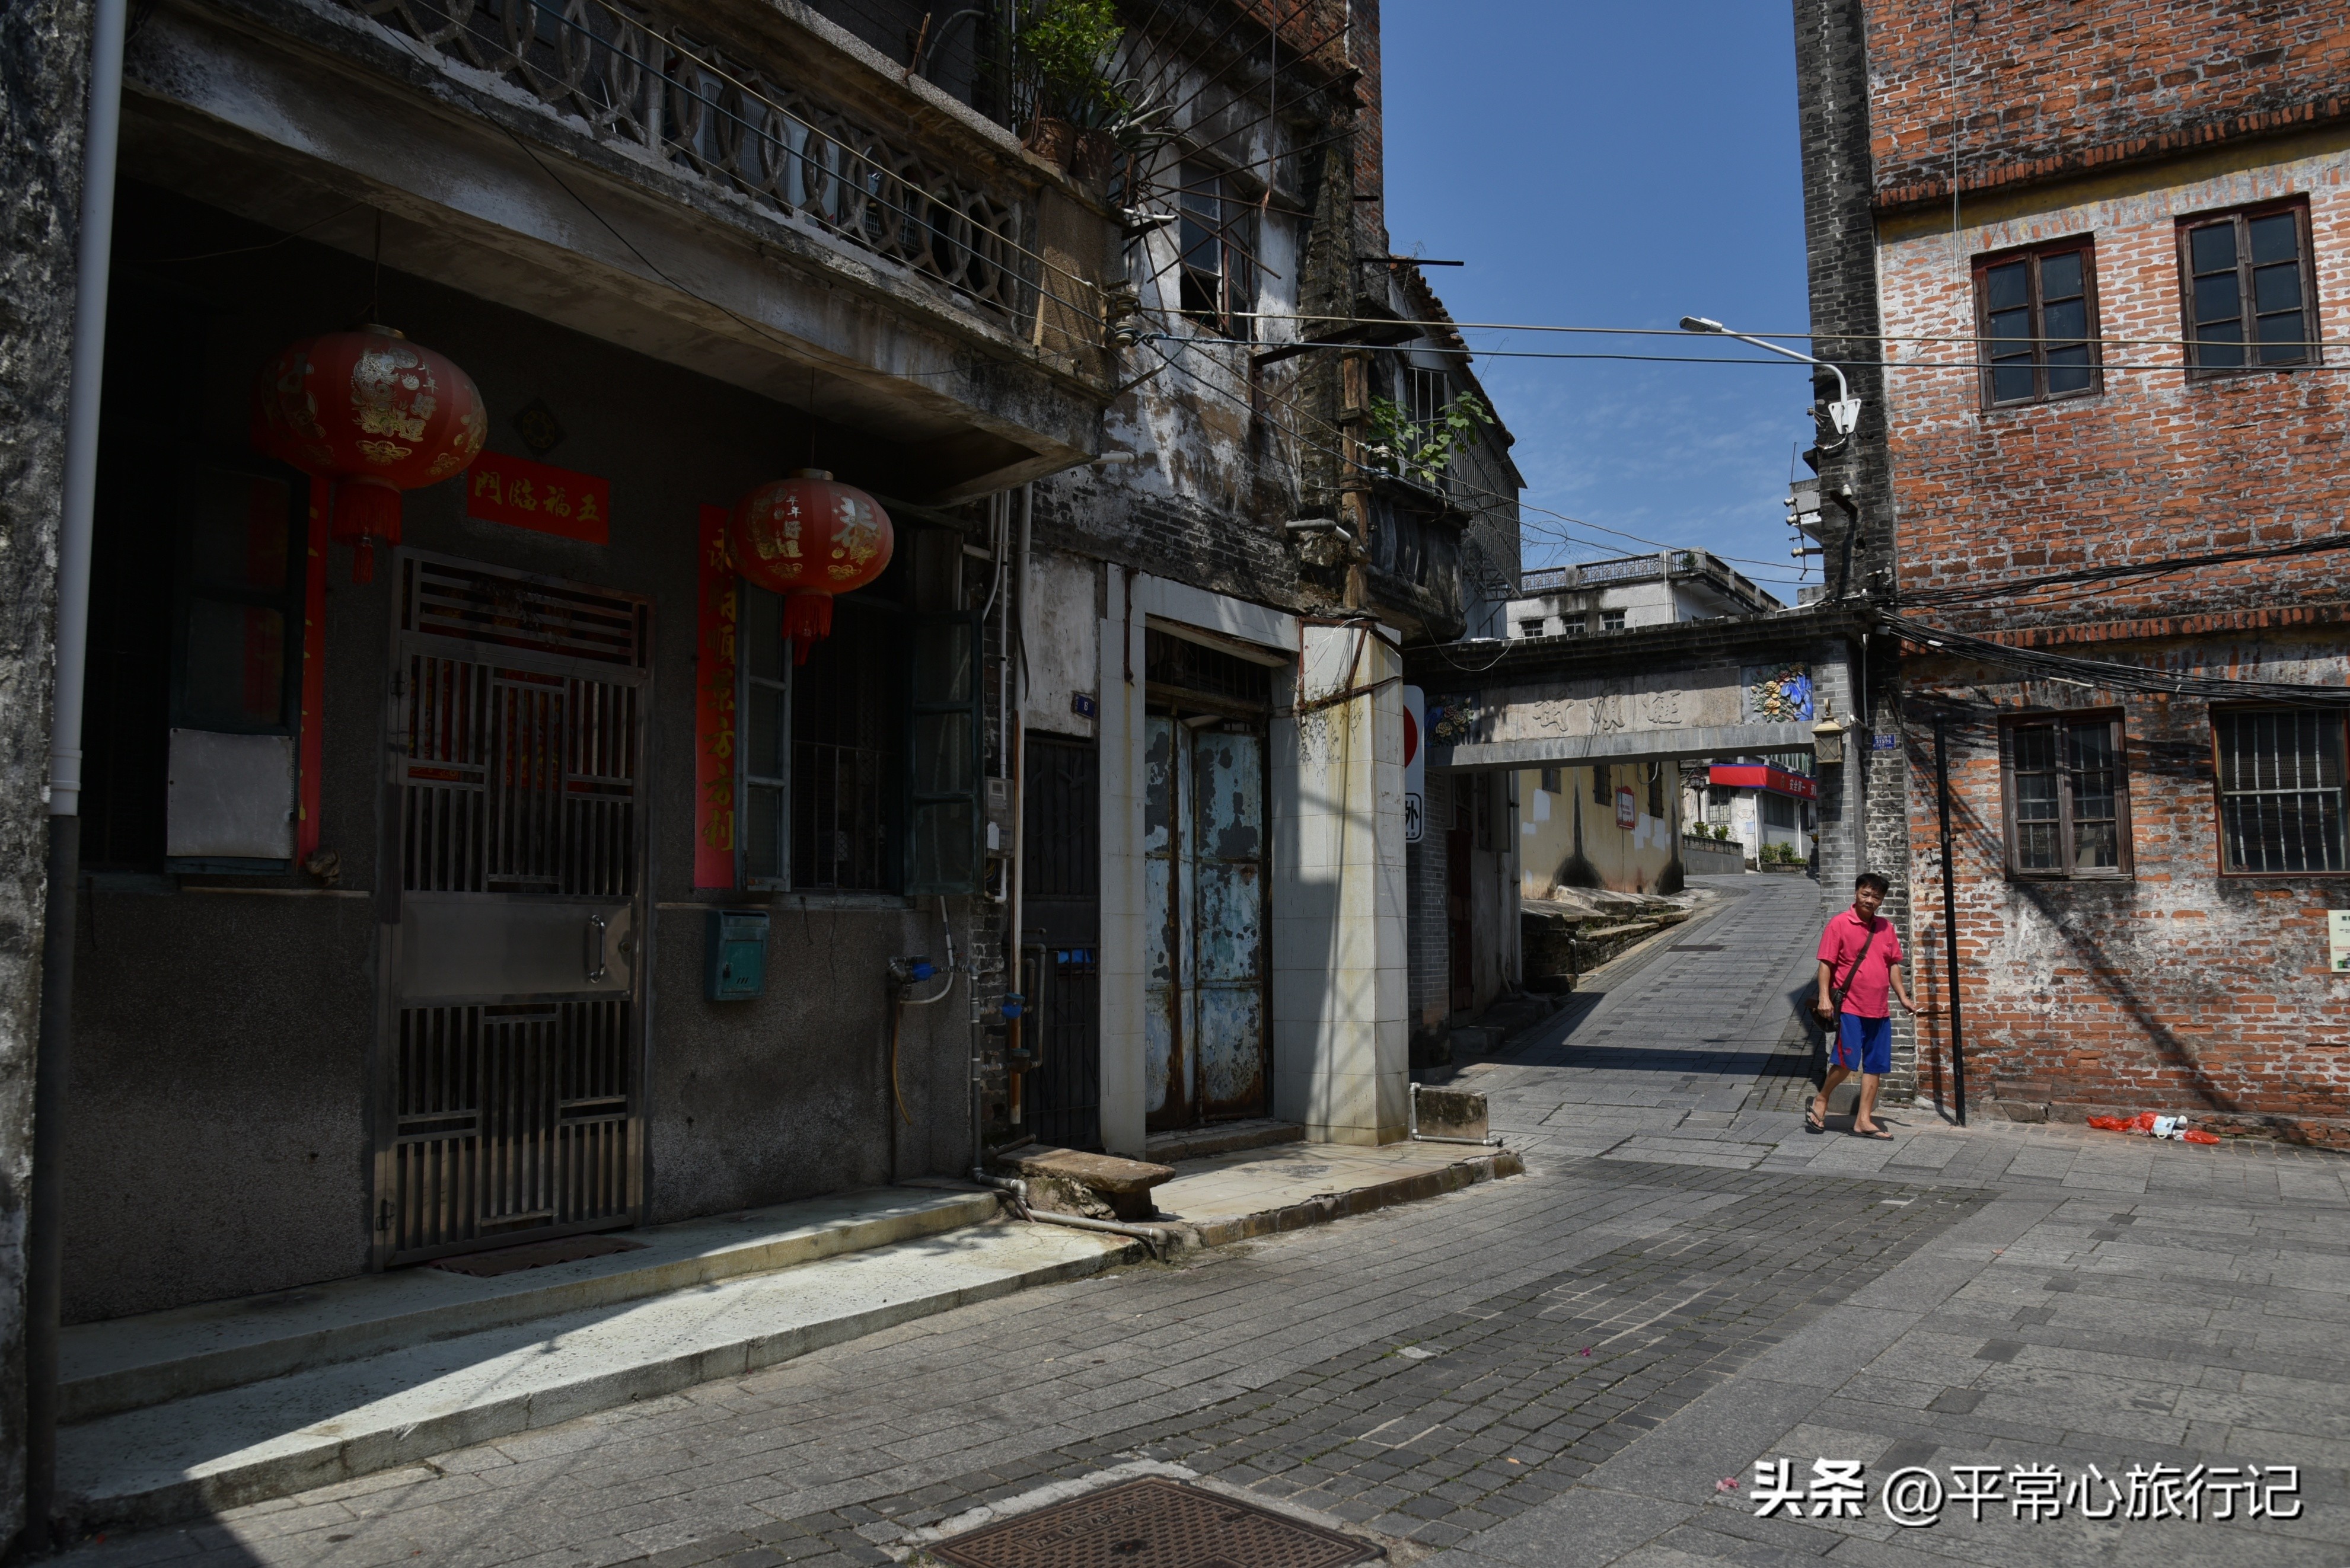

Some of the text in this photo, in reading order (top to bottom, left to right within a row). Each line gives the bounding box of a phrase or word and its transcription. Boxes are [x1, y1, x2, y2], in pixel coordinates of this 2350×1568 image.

[475, 470, 600, 522] 五福臨門
[1084, 701, 1089, 711] 6
[1789, 778, 1806, 793] 安全第一
